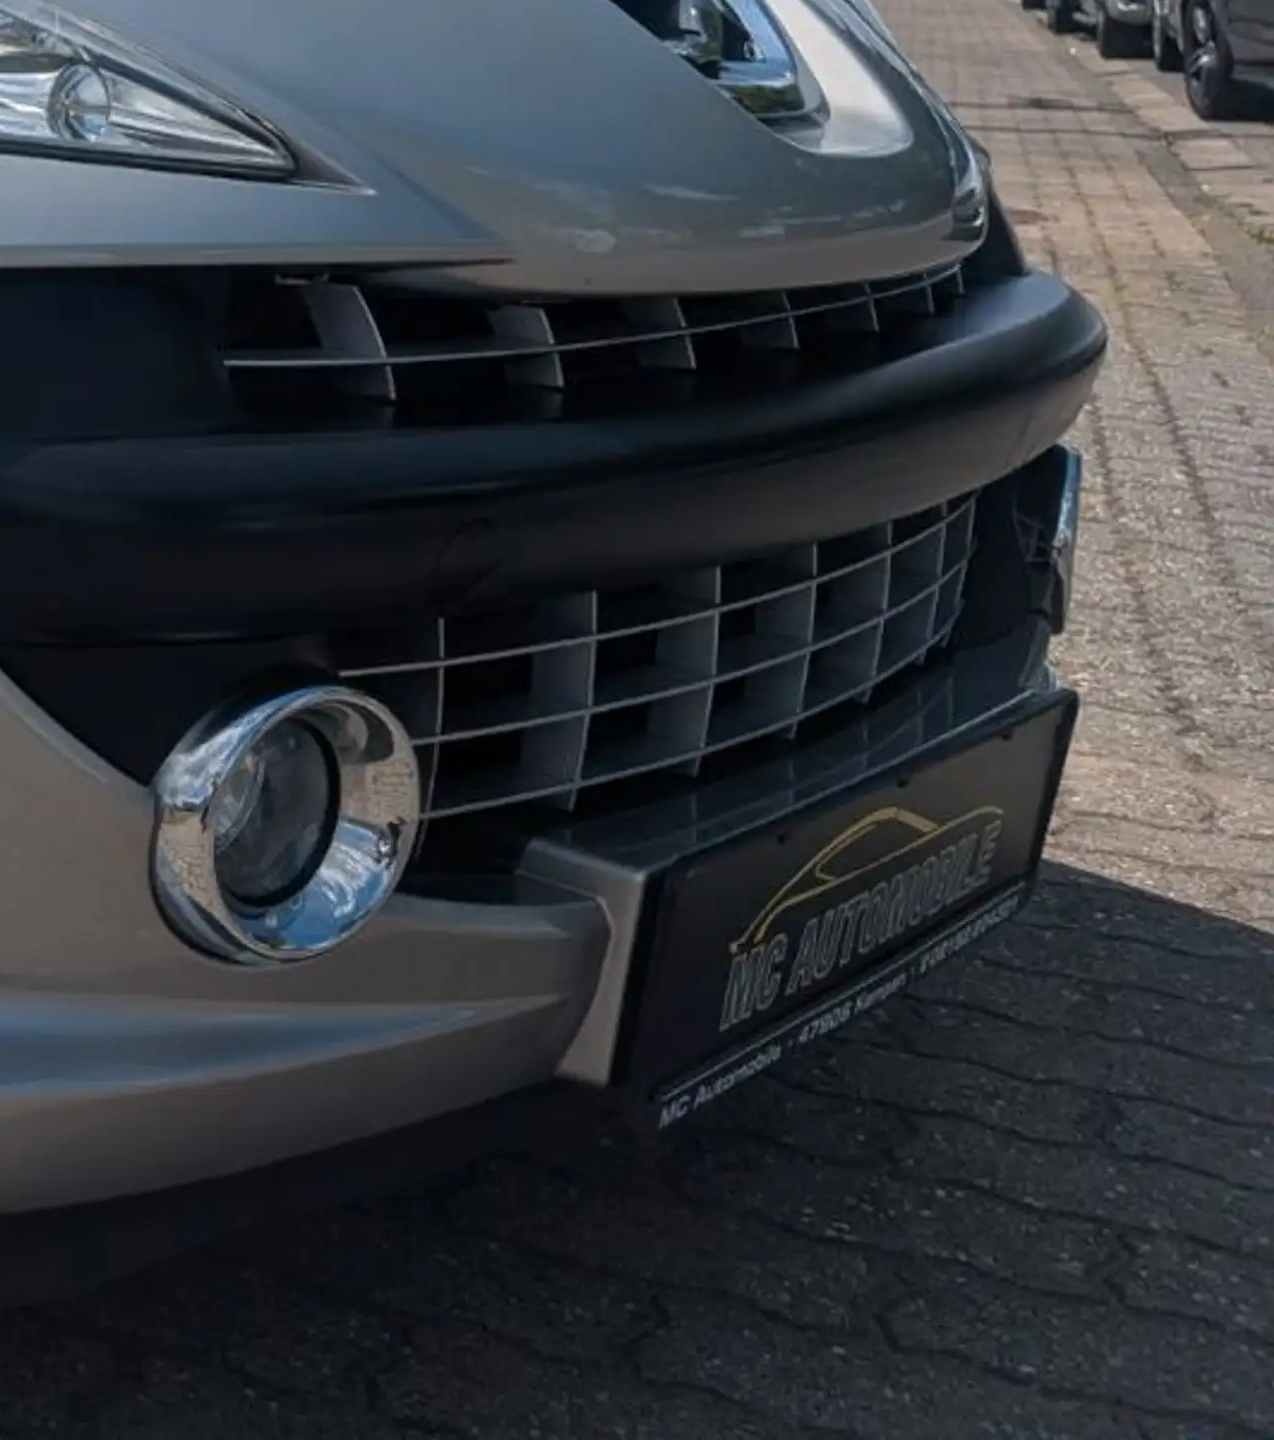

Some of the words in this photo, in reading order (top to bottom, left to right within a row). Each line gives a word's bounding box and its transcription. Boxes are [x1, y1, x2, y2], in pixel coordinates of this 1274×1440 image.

[719, 933, 789, 1032] MC
[785, 820, 1003, 997] AUTOMOBILE
[657, 1094, 692, 1130] MC
